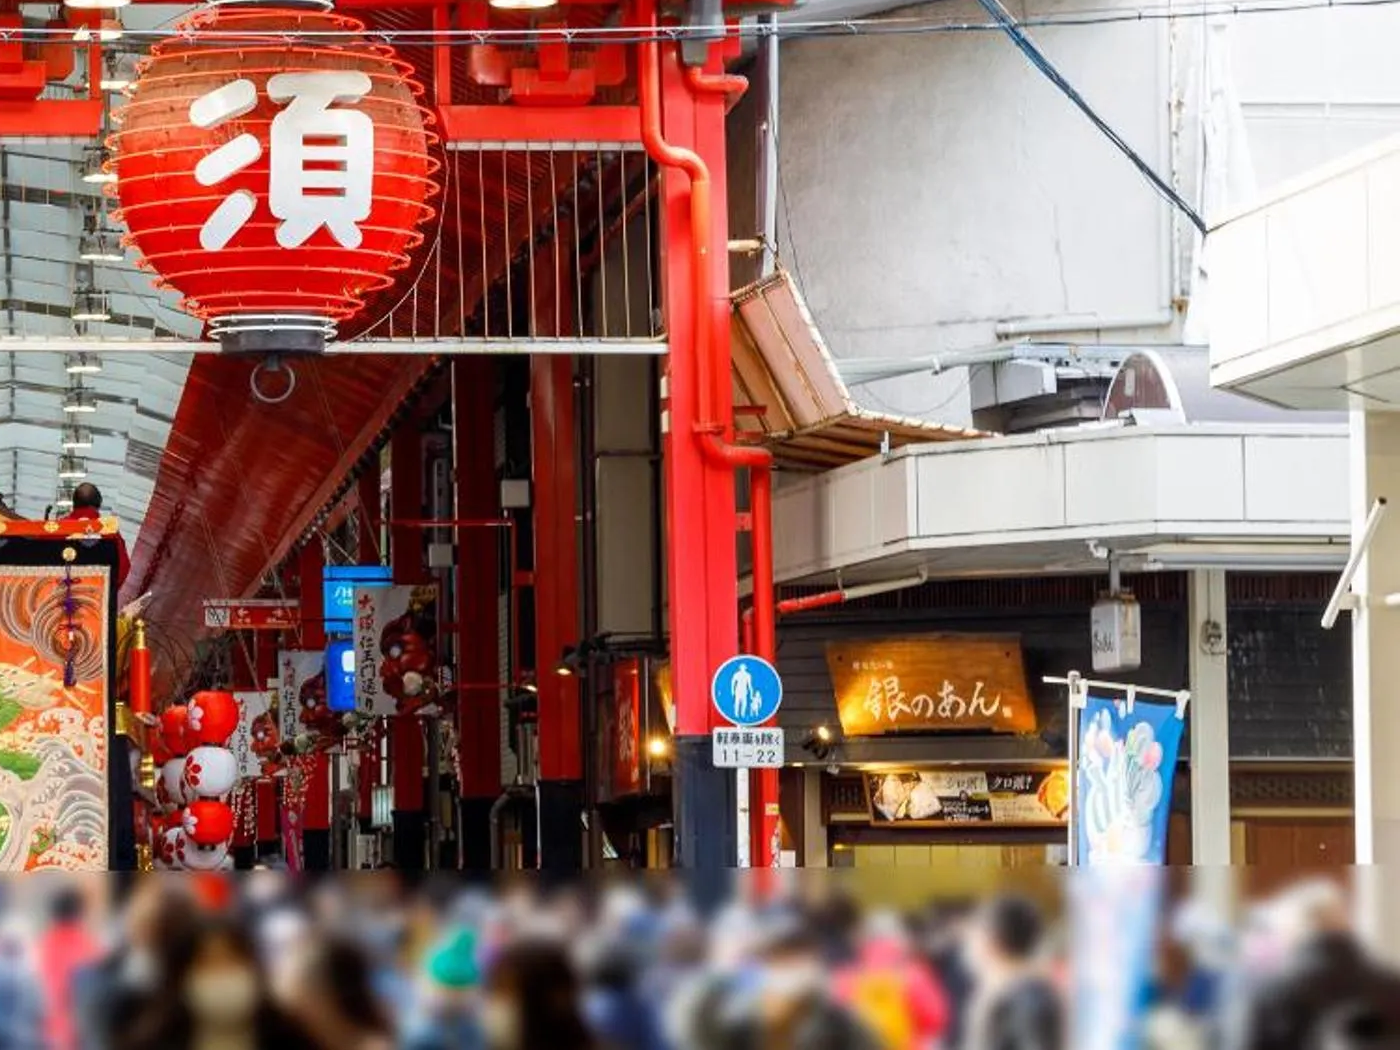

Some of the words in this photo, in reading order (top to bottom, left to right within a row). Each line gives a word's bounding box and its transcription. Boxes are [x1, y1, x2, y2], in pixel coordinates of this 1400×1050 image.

[188, 70, 374, 249] 須
[863, 675, 1001, 723] 銀のあん
[722, 749, 776, 763] 11-22
